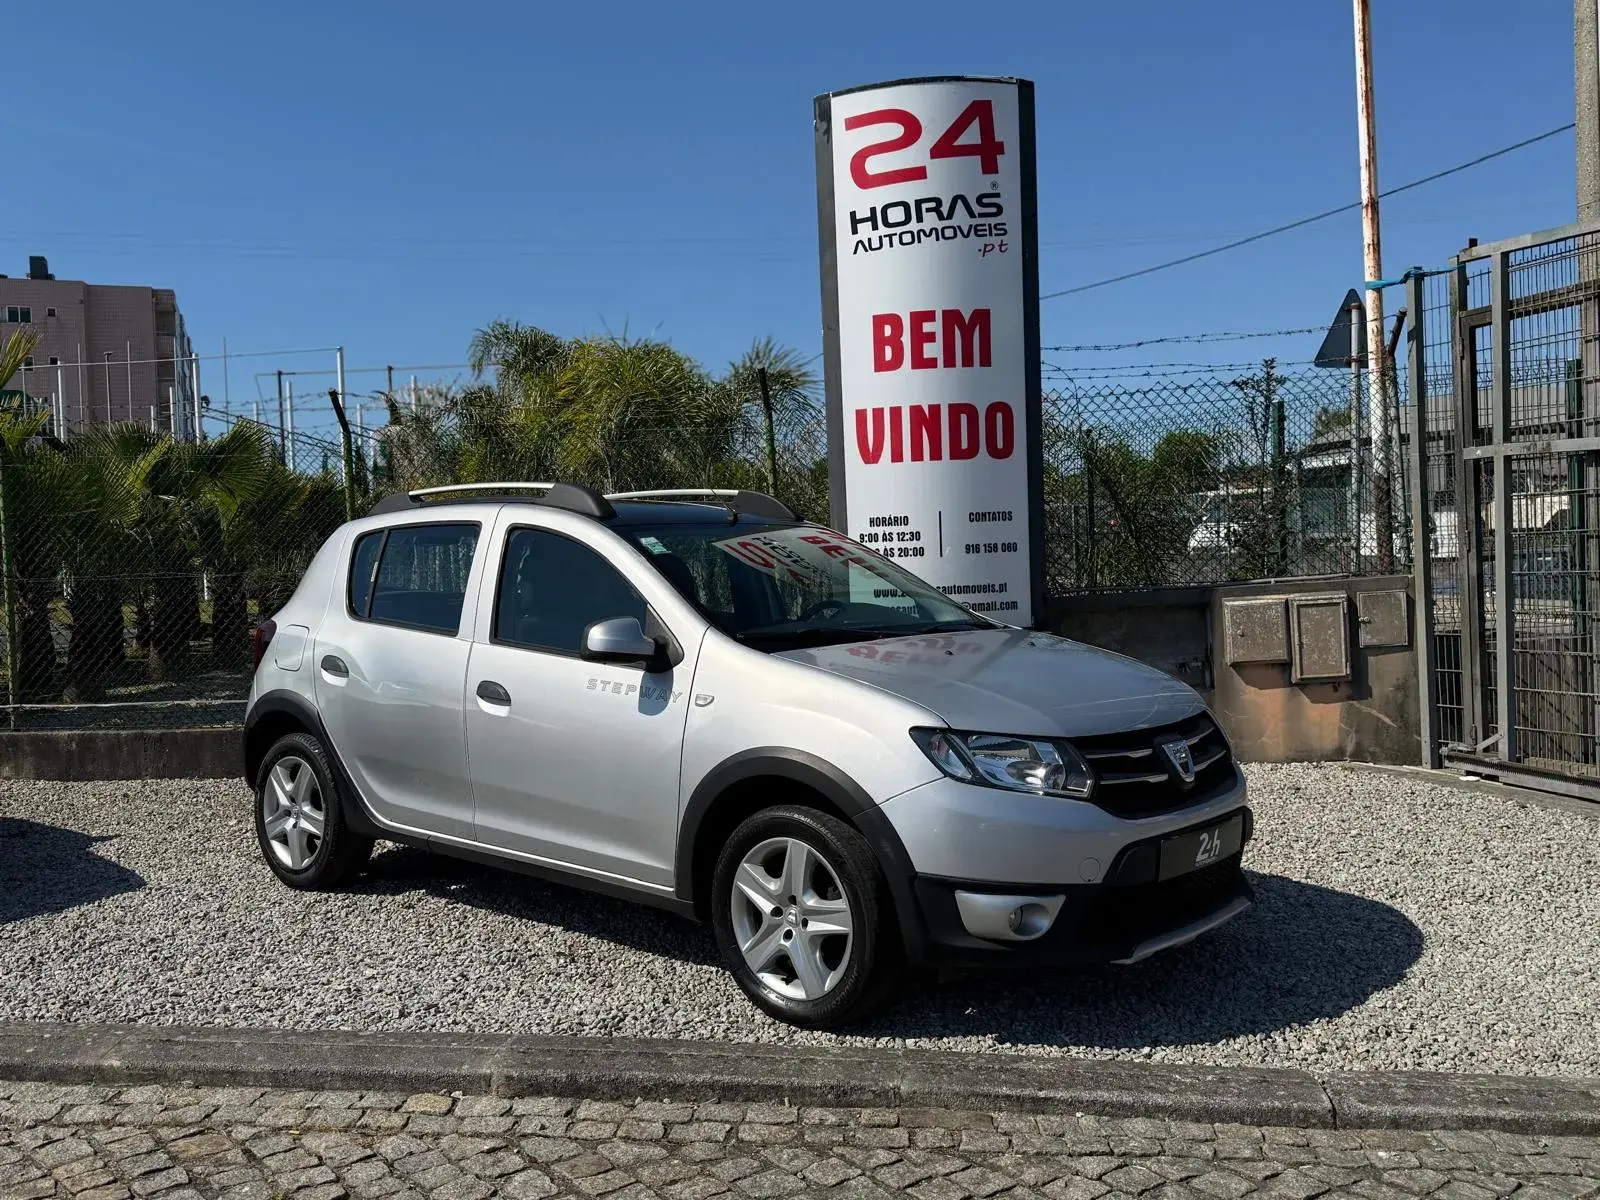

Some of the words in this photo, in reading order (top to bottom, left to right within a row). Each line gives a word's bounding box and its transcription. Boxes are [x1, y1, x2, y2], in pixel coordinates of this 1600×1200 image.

[845, 100, 1004, 189] 24
[850, 193, 1003, 235] HORAS
[853, 222, 1008, 255] AUTOMOVEIS
[978, 239, 1008, 257] .pt
[872, 308, 992, 373] BEM
[855, 401, 1015, 464] VINDO
[869, 513, 909, 527] HORÁRIO
[968, 511, 1013, 522] CONTATOS
[859, 533, 879, 543] 9:00
[896, 531, 921, 542] 12:30
[897, 546, 925, 557] 20:00
[965, 543, 980, 554] 916
[983, 542, 998, 553] 158
[1001, 542, 1018, 553] 060
[586, 678, 683, 703] STEPWAY
